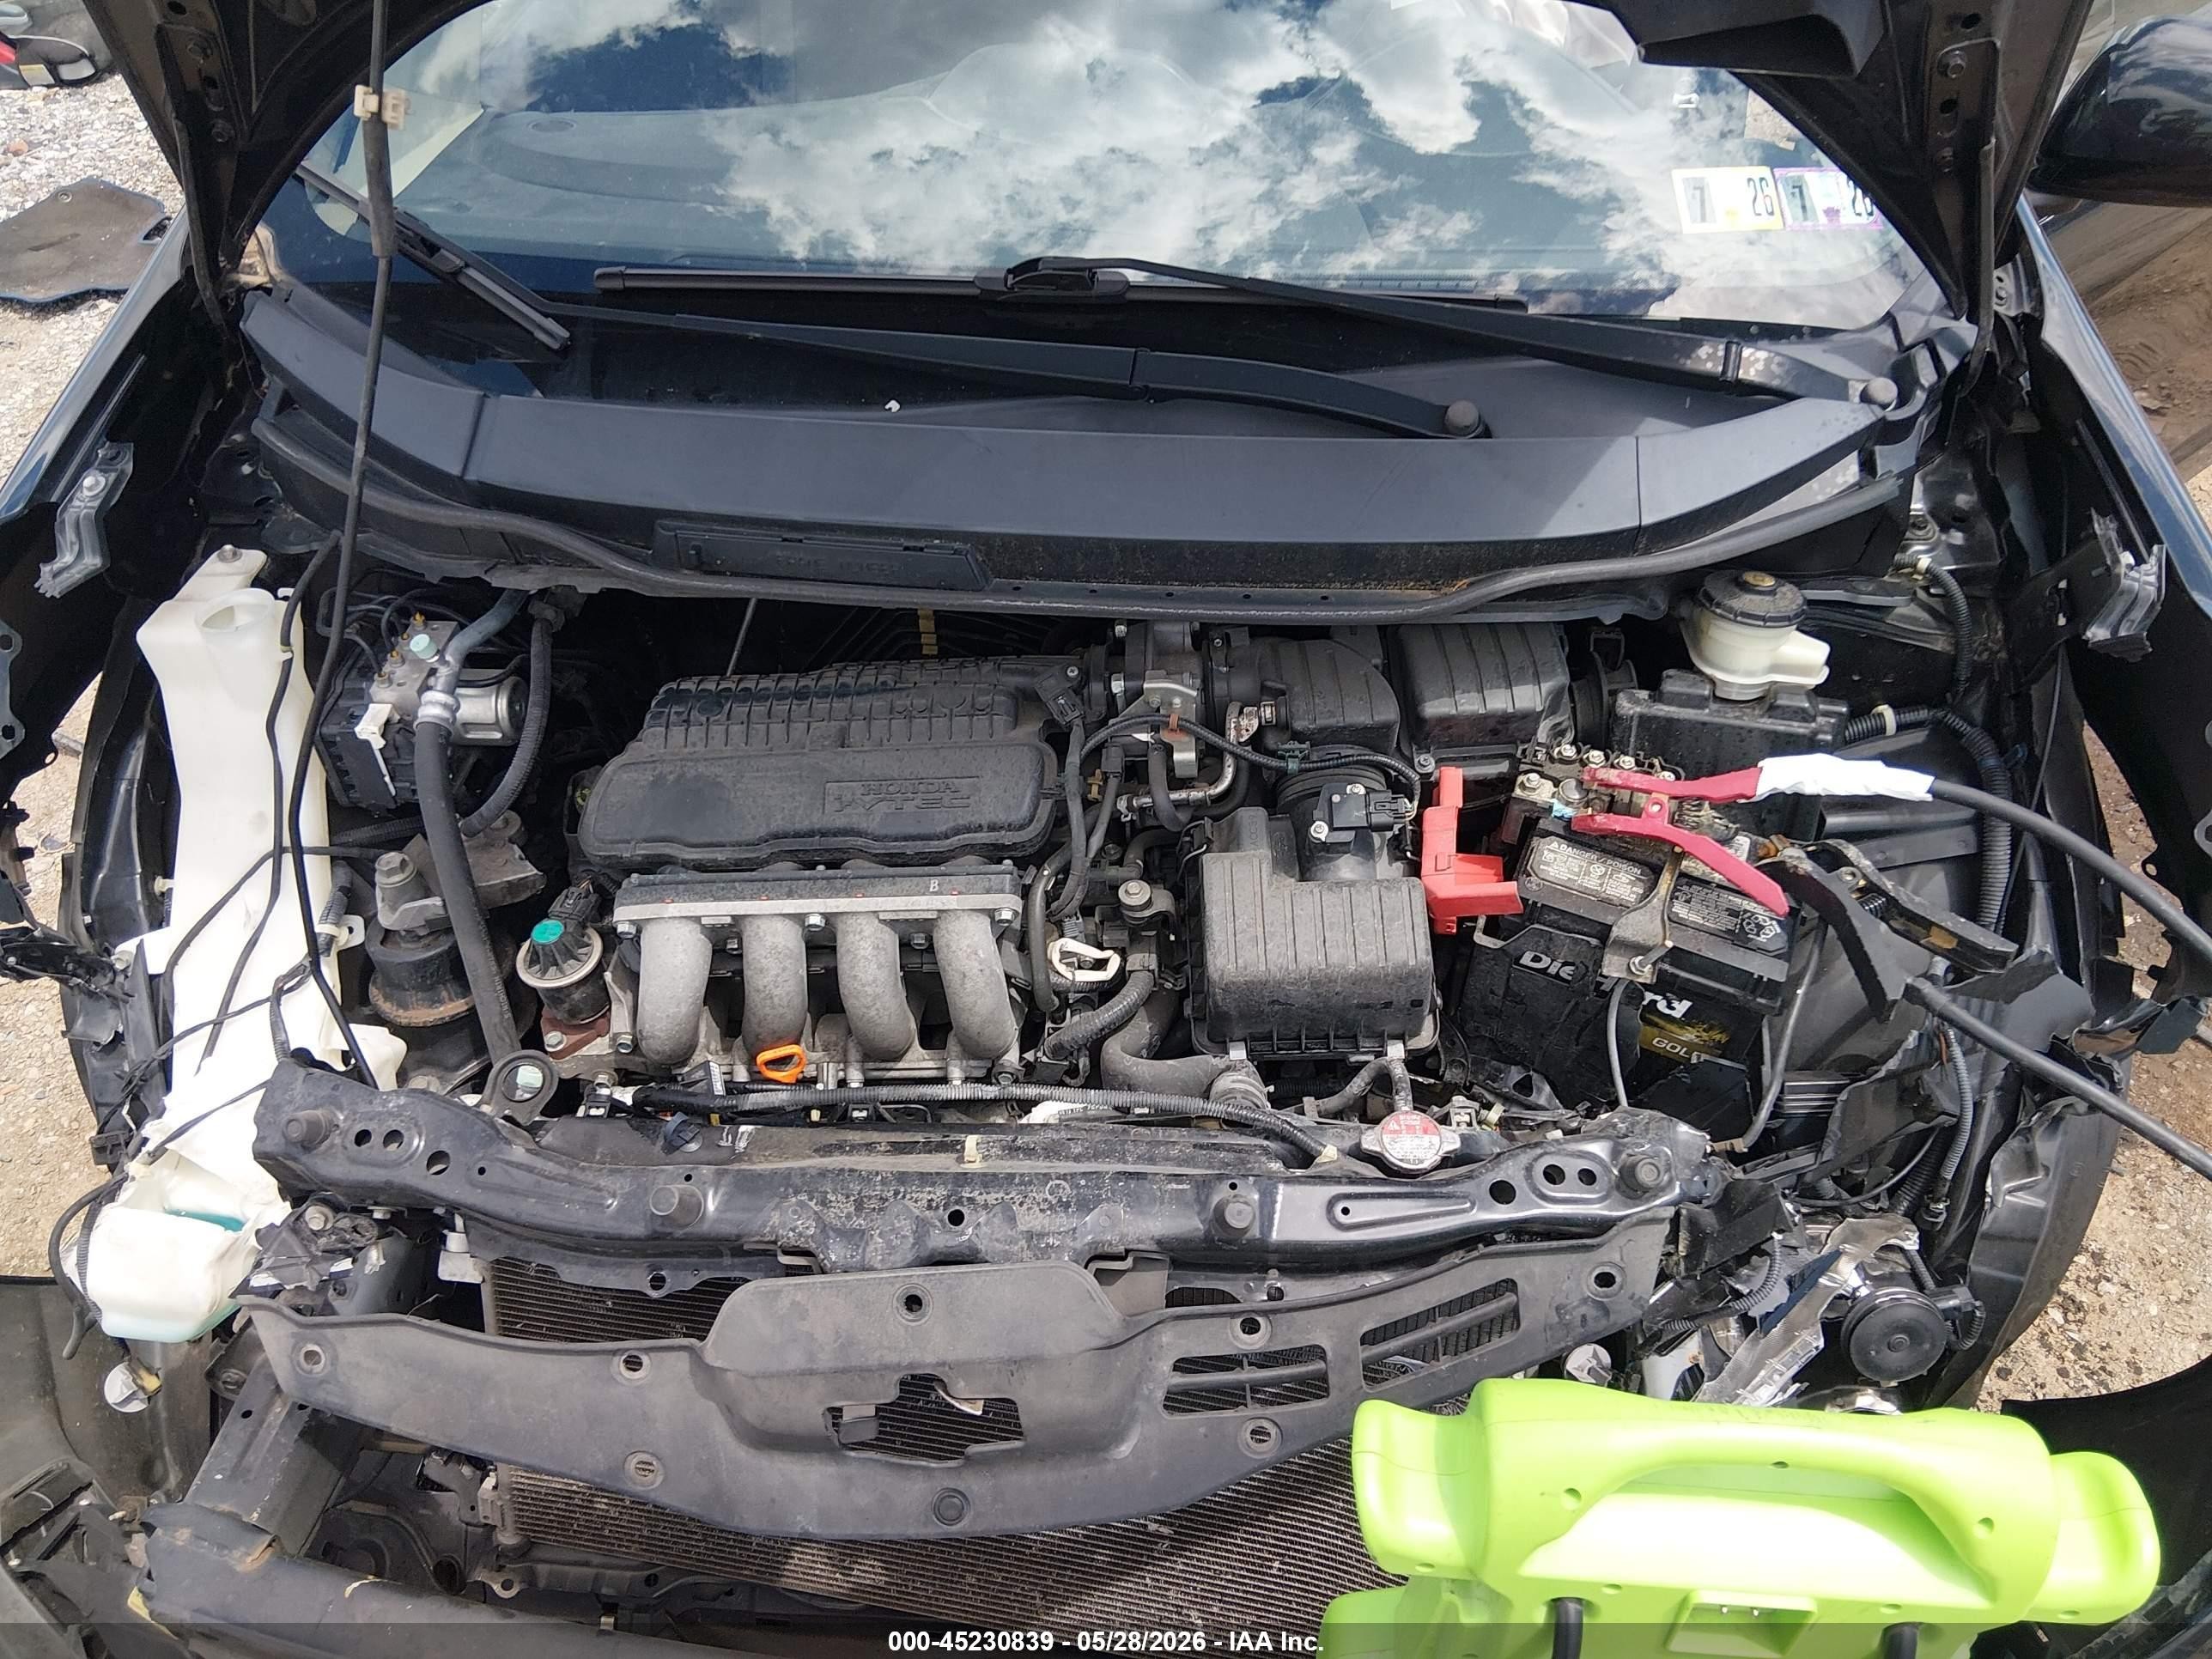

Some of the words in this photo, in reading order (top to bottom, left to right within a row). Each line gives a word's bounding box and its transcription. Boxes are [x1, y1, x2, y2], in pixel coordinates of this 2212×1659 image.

[1746, 177, 1775, 216] 26
[860, 781, 961, 796] HONDA
[1607, 859, 1642, 875] POISON
[929, 878, 939, 892] B
